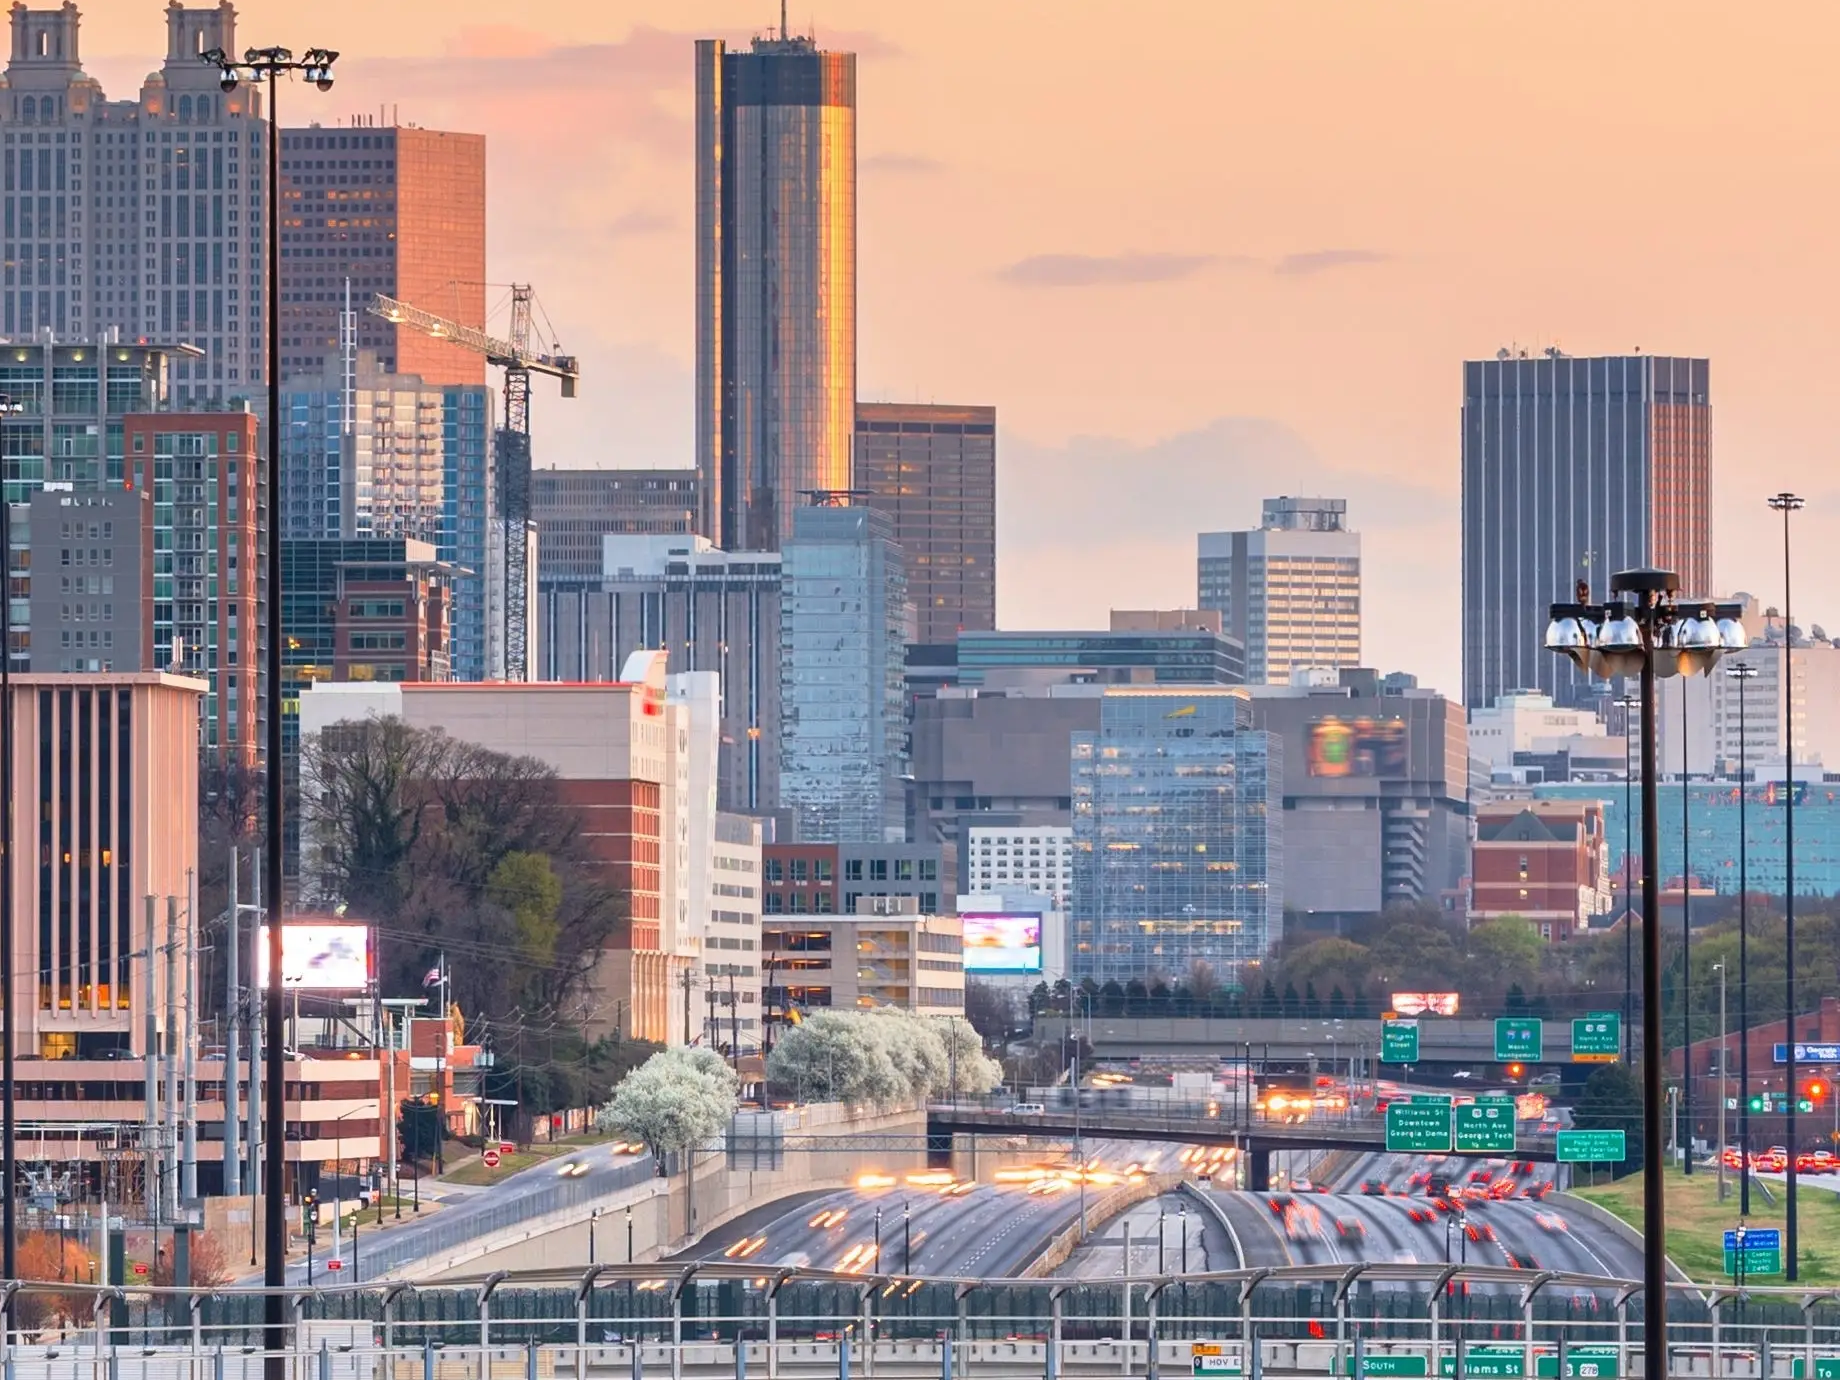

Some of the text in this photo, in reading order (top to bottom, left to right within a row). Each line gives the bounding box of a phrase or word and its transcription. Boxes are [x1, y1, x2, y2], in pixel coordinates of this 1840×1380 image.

[1390, 1130, 1422, 1138] Georgia
[1458, 1132, 1490, 1140] Georgia
[1209, 1358, 1229, 1366] HOV
[1444, 1364, 1519, 1374] Wliams St
[1818, 1368, 1832, 1378] To
